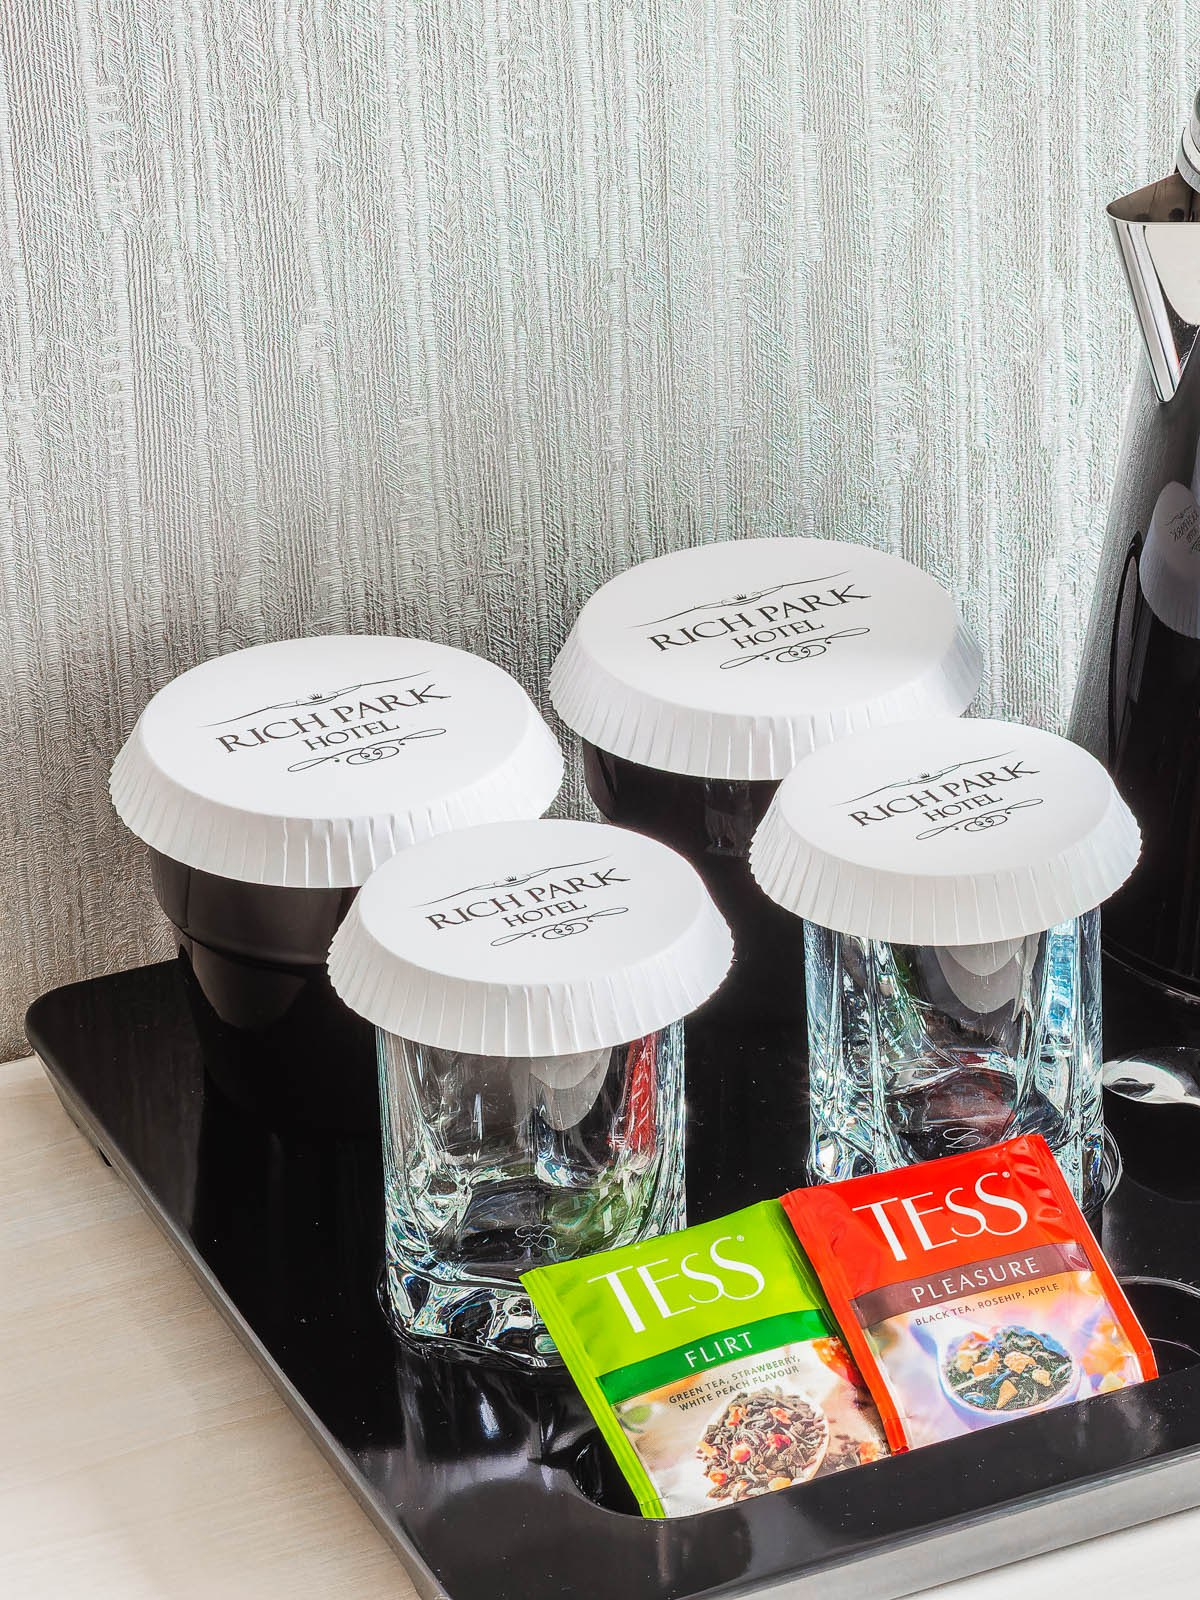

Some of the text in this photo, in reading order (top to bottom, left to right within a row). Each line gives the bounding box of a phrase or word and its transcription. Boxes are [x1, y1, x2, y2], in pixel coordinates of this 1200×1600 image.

[647, 584, 871, 651] RICH PARK
[732, 620, 824, 649] HOTEL
[216, 684, 451, 753] RICH PARK
[302, 720, 400, 751] HOTEL
[848, 761, 1040, 826] RICH PARK
[923, 794, 1003, 821] HOTEL
[425, 868, 631, 930] RICH PARK
[502, 900, 587, 927] HOTEL
[852, 1171, 1028, 1261] TESS
[587, 1236, 765, 1334] TESS
[911, 1256, 1041, 1303] PLEASURE
[915, 1283, 1060, 1326] BLACK TEA, ROSEHIP, APPLE
[684, 1332, 753, 1368] FLIRT
[669, 1354, 800, 1404] GREEN TEA, STRAWBERRY,
[678, 1365, 800, 1412] WHITE PEACH FLAVOUR
